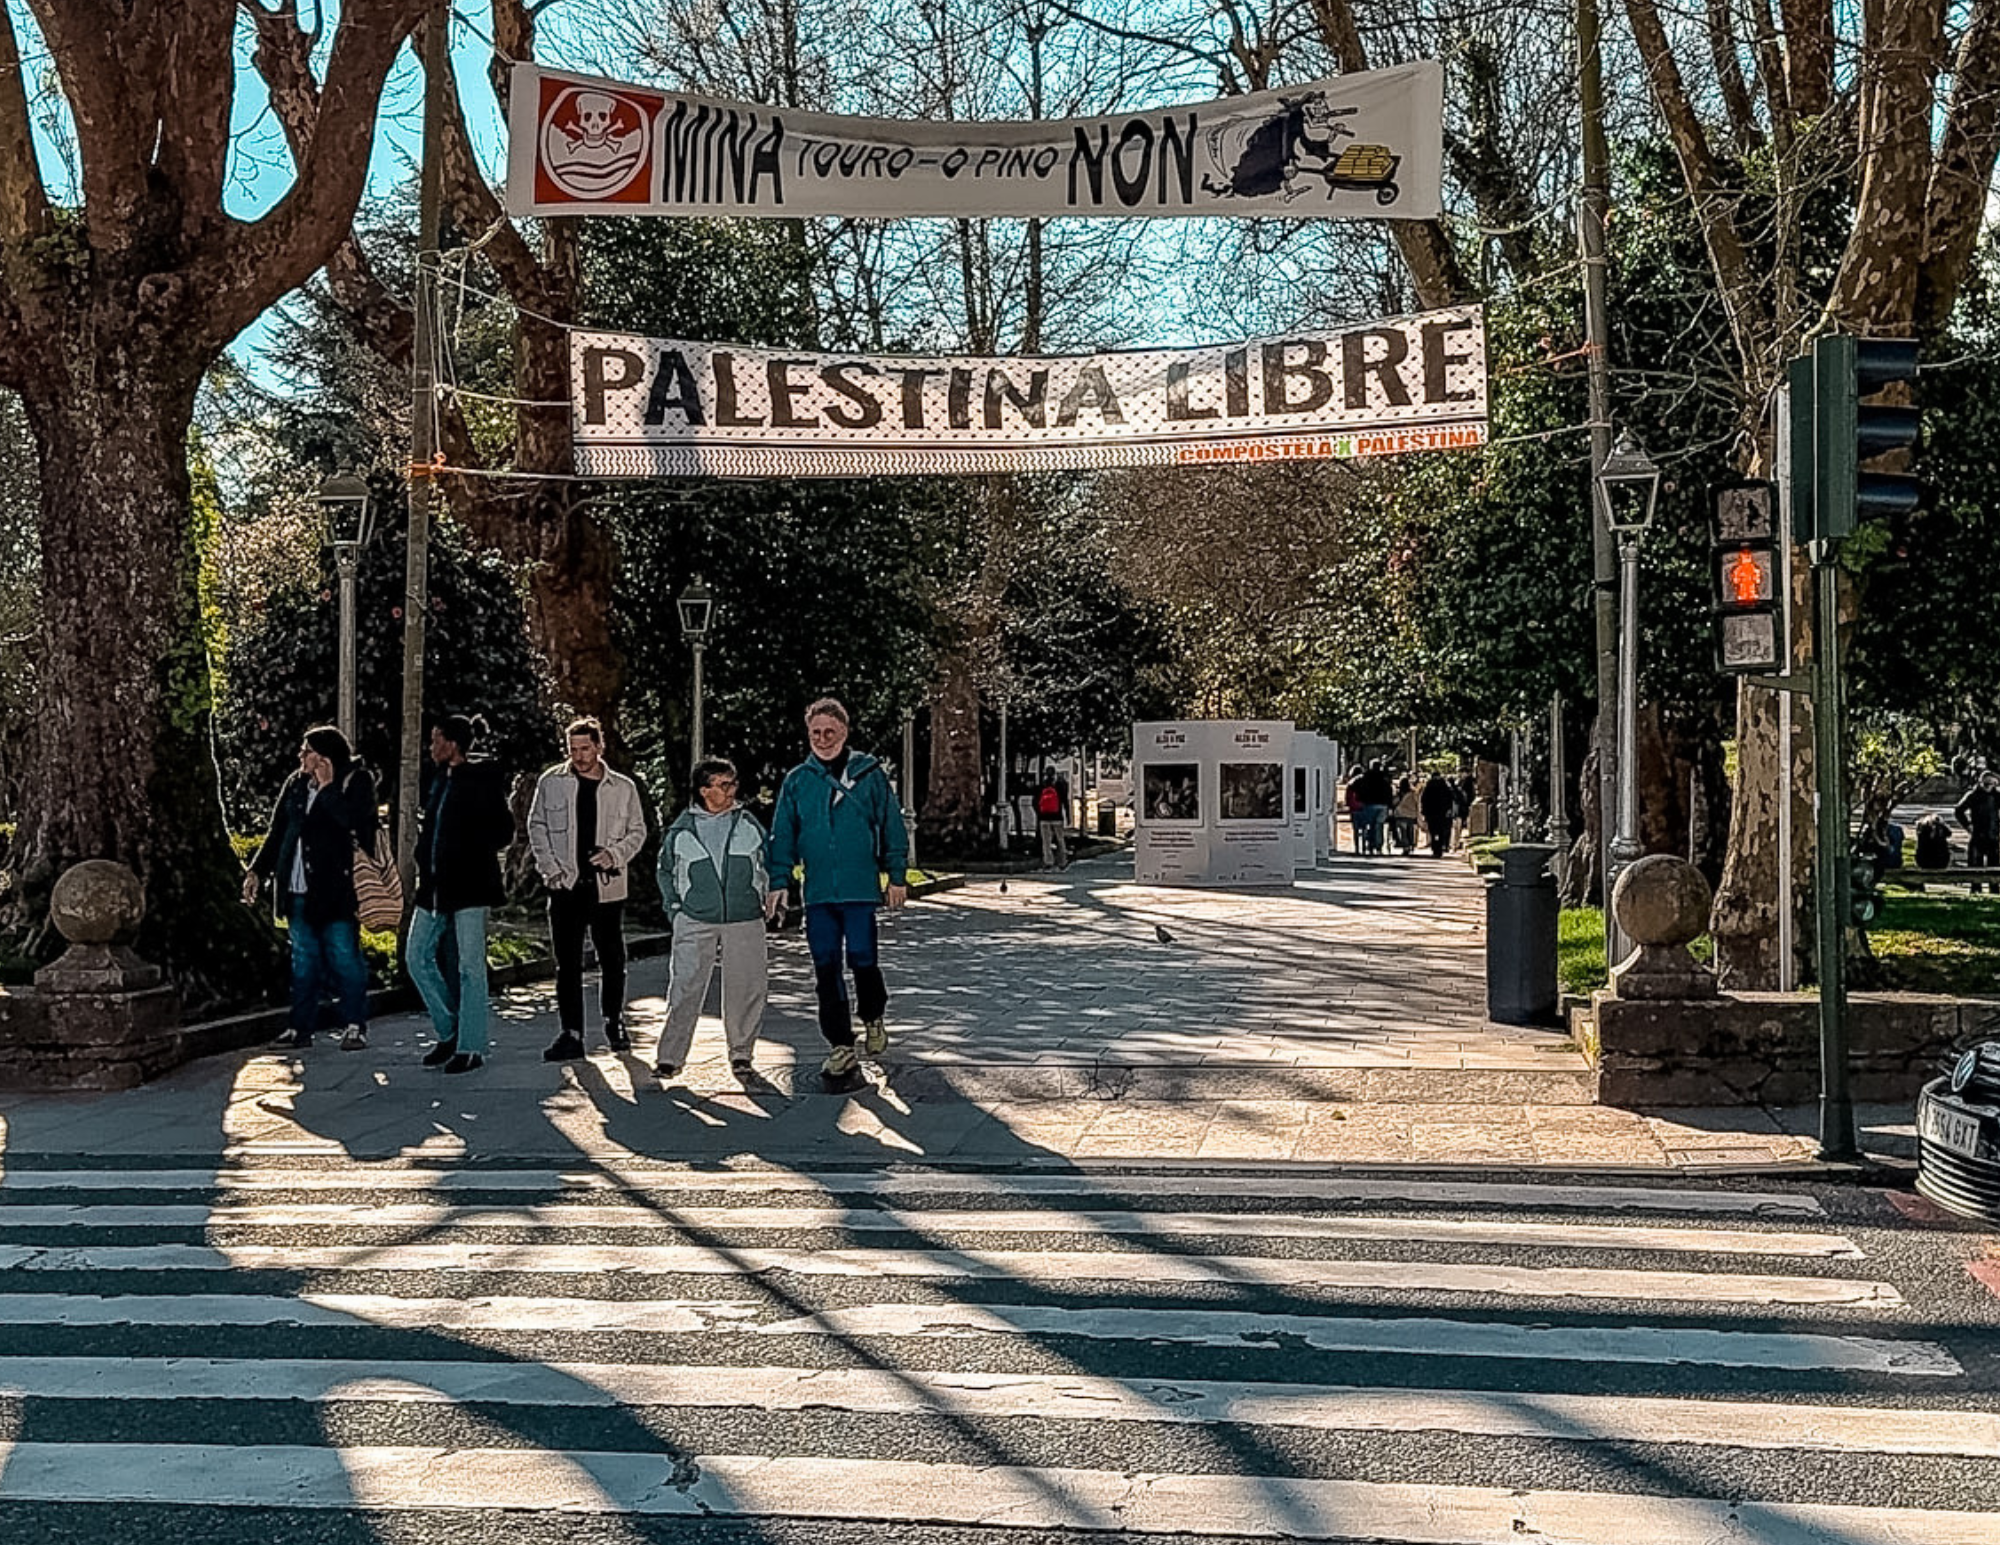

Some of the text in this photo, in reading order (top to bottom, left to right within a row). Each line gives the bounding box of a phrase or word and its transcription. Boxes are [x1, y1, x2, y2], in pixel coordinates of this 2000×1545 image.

[662, 99, 784, 204] MINA
[975, 146, 1060, 178] PINO
[1067, 112, 1198, 206] NON
[583, 319, 1477, 430] PALESTINA LIBRE
[1178, 442, 1334, 462] COMPOSTELA
[1357, 429, 1481, 454] PALESTINA
